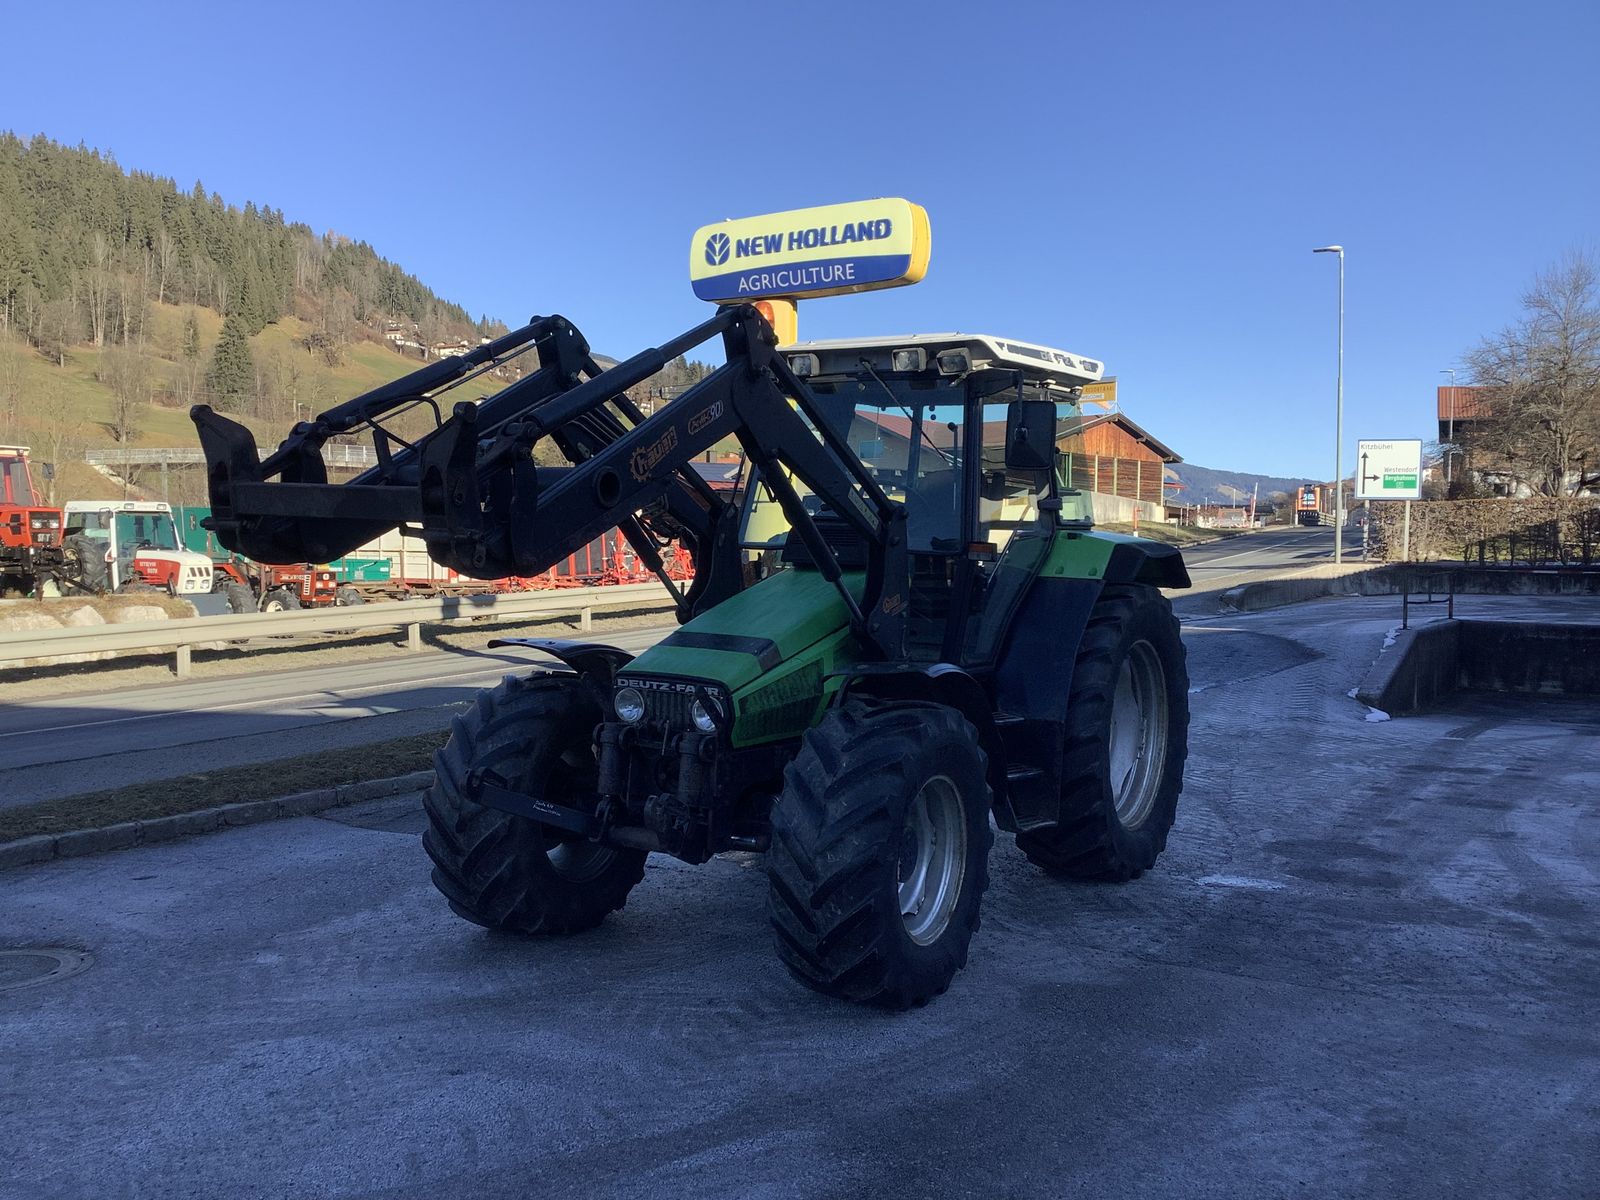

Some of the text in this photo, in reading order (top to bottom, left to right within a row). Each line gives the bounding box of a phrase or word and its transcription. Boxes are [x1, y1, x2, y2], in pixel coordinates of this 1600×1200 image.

[735, 218, 892, 258] NEW HOLLAND
[738, 263, 855, 292] AGRICULTURE
[617, 678, 720, 697] DEUTZ-FAR
